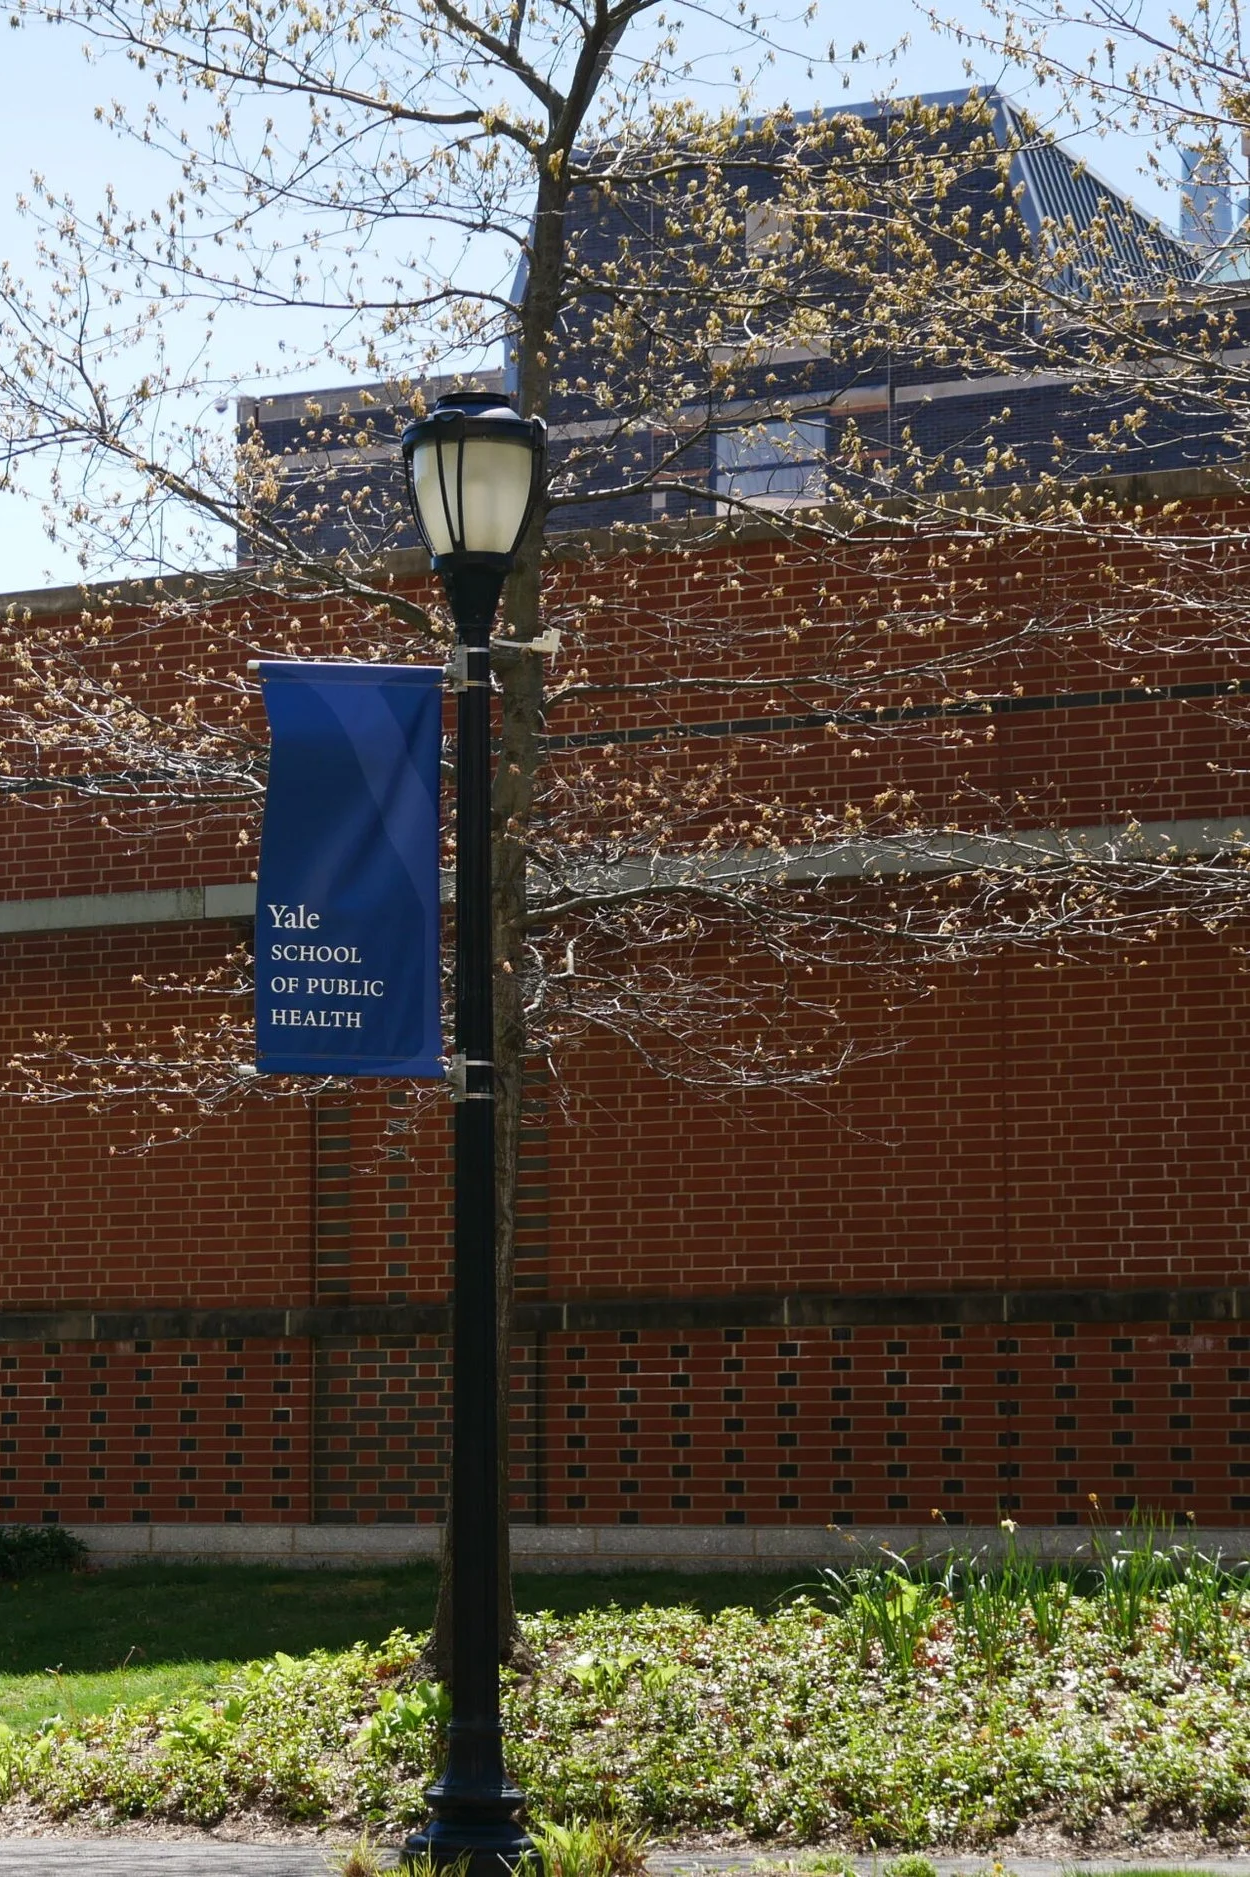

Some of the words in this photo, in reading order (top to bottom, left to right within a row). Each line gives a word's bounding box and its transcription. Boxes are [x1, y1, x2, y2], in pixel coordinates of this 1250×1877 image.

[267, 904, 320, 930] Yale
[270, 944, 362, 963] SCHOOL
[270, 976, 299, 994] OF
[306, 977, 384, 997] PUBLIC
[270, 1008, 362, 1028] HEALTH
